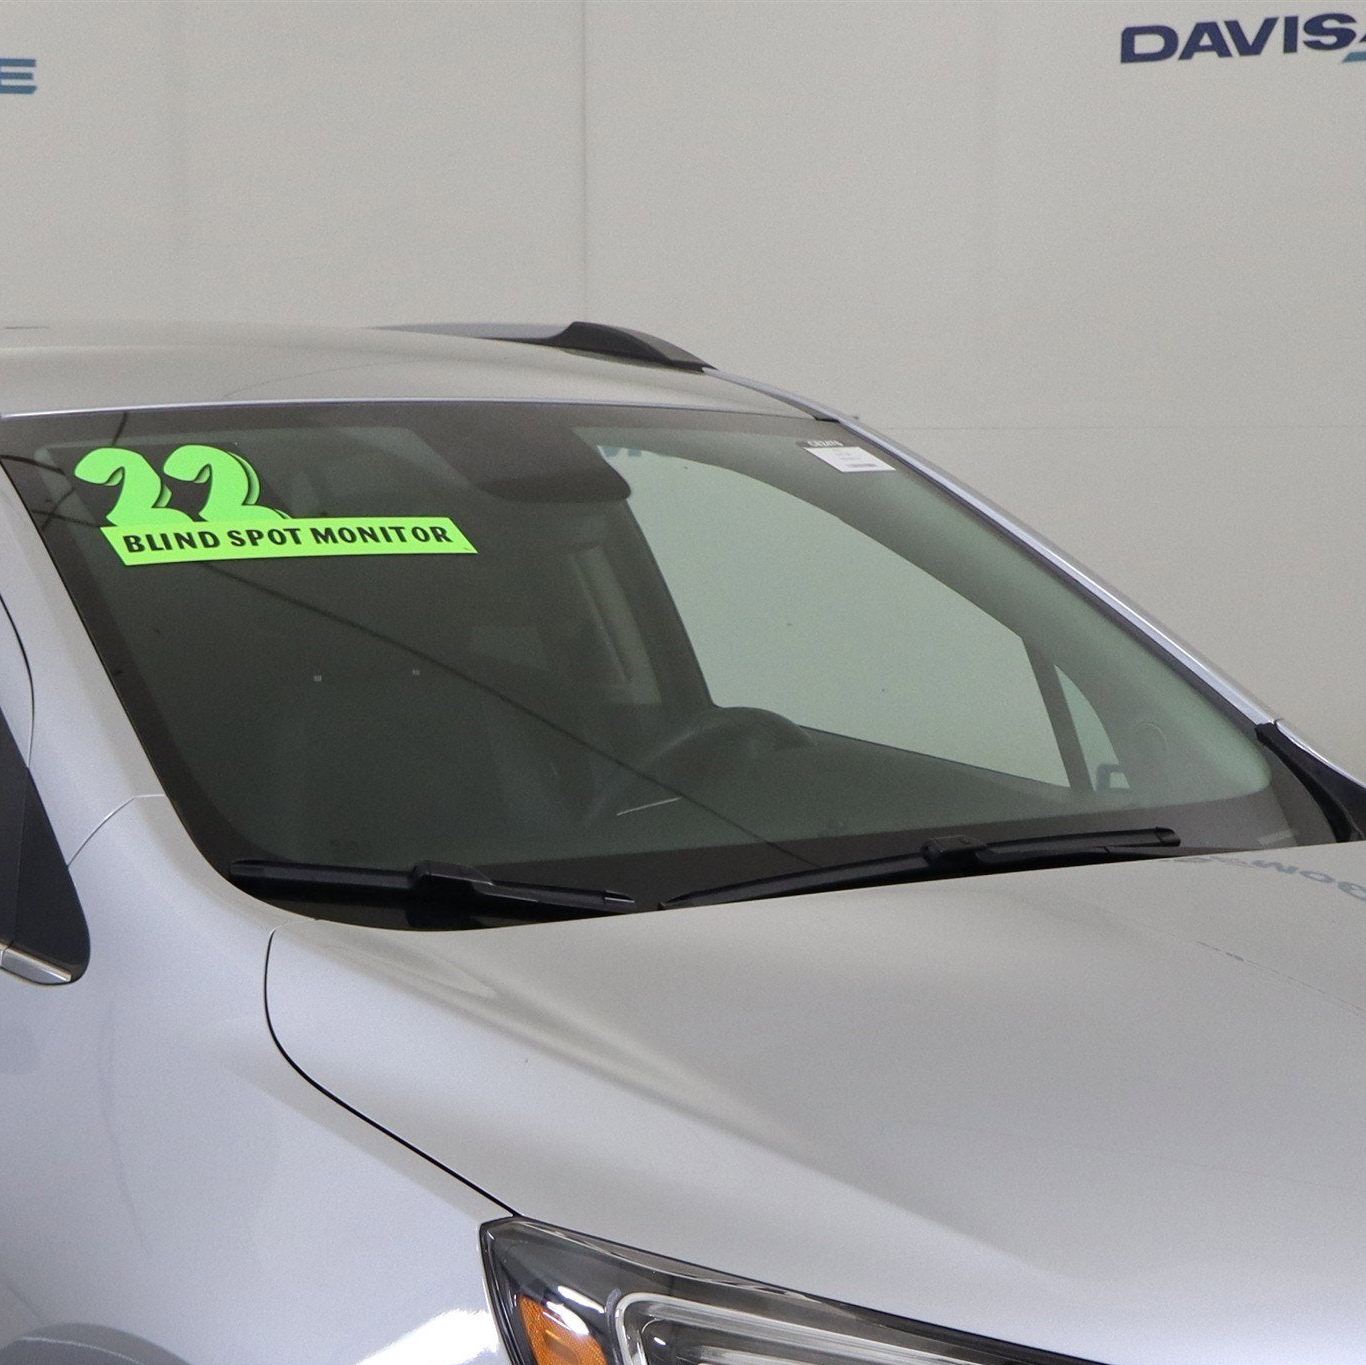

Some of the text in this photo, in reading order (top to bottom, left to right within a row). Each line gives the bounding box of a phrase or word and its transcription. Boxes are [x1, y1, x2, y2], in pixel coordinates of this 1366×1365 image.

[1119, 13, 1357, 63] DAVIS
[74, 444, 293, 527] 22
[123, 526, 454, 554] BLIND SPOT MONITOR
